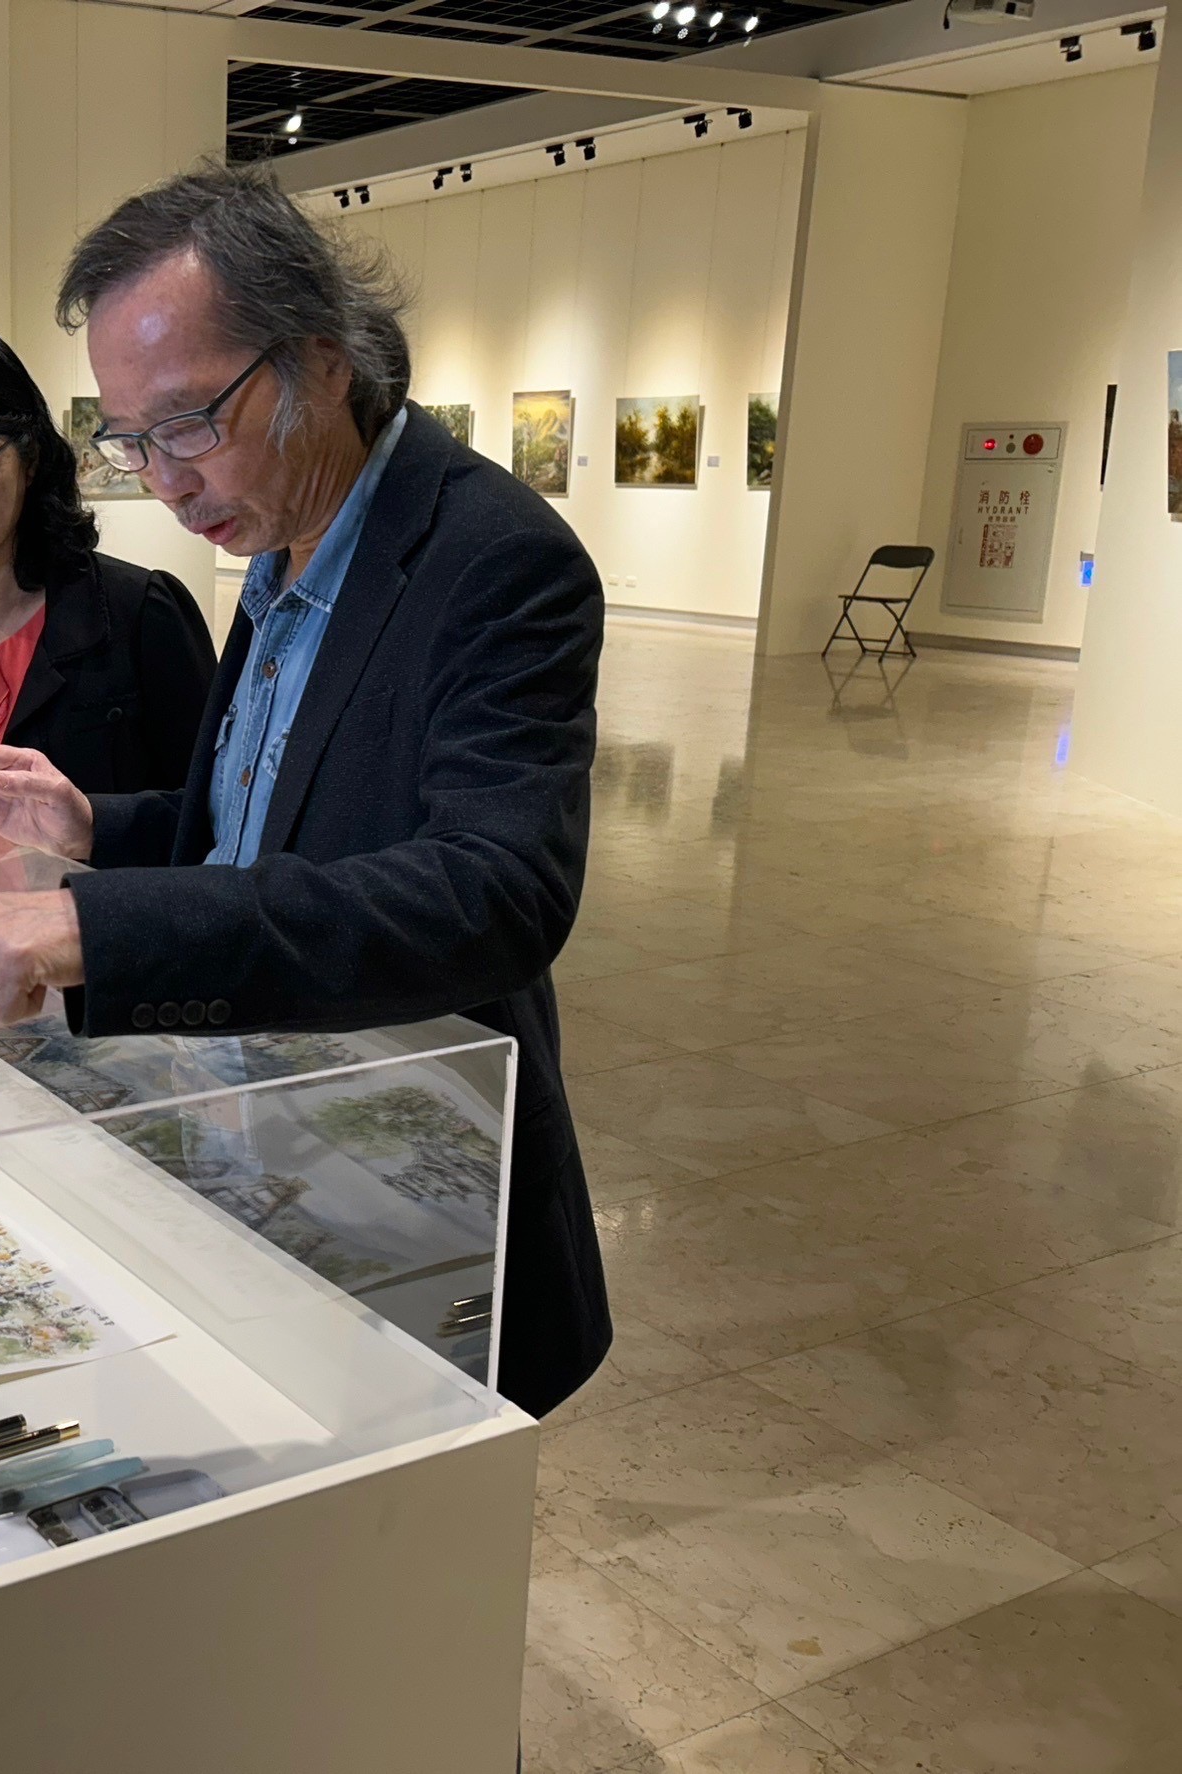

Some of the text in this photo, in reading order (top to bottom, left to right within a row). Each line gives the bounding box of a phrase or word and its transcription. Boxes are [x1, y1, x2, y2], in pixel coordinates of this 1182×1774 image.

[978, 490, 1030, 505] 消防栓
[977, 506, 1029, 514] HYDRANT
